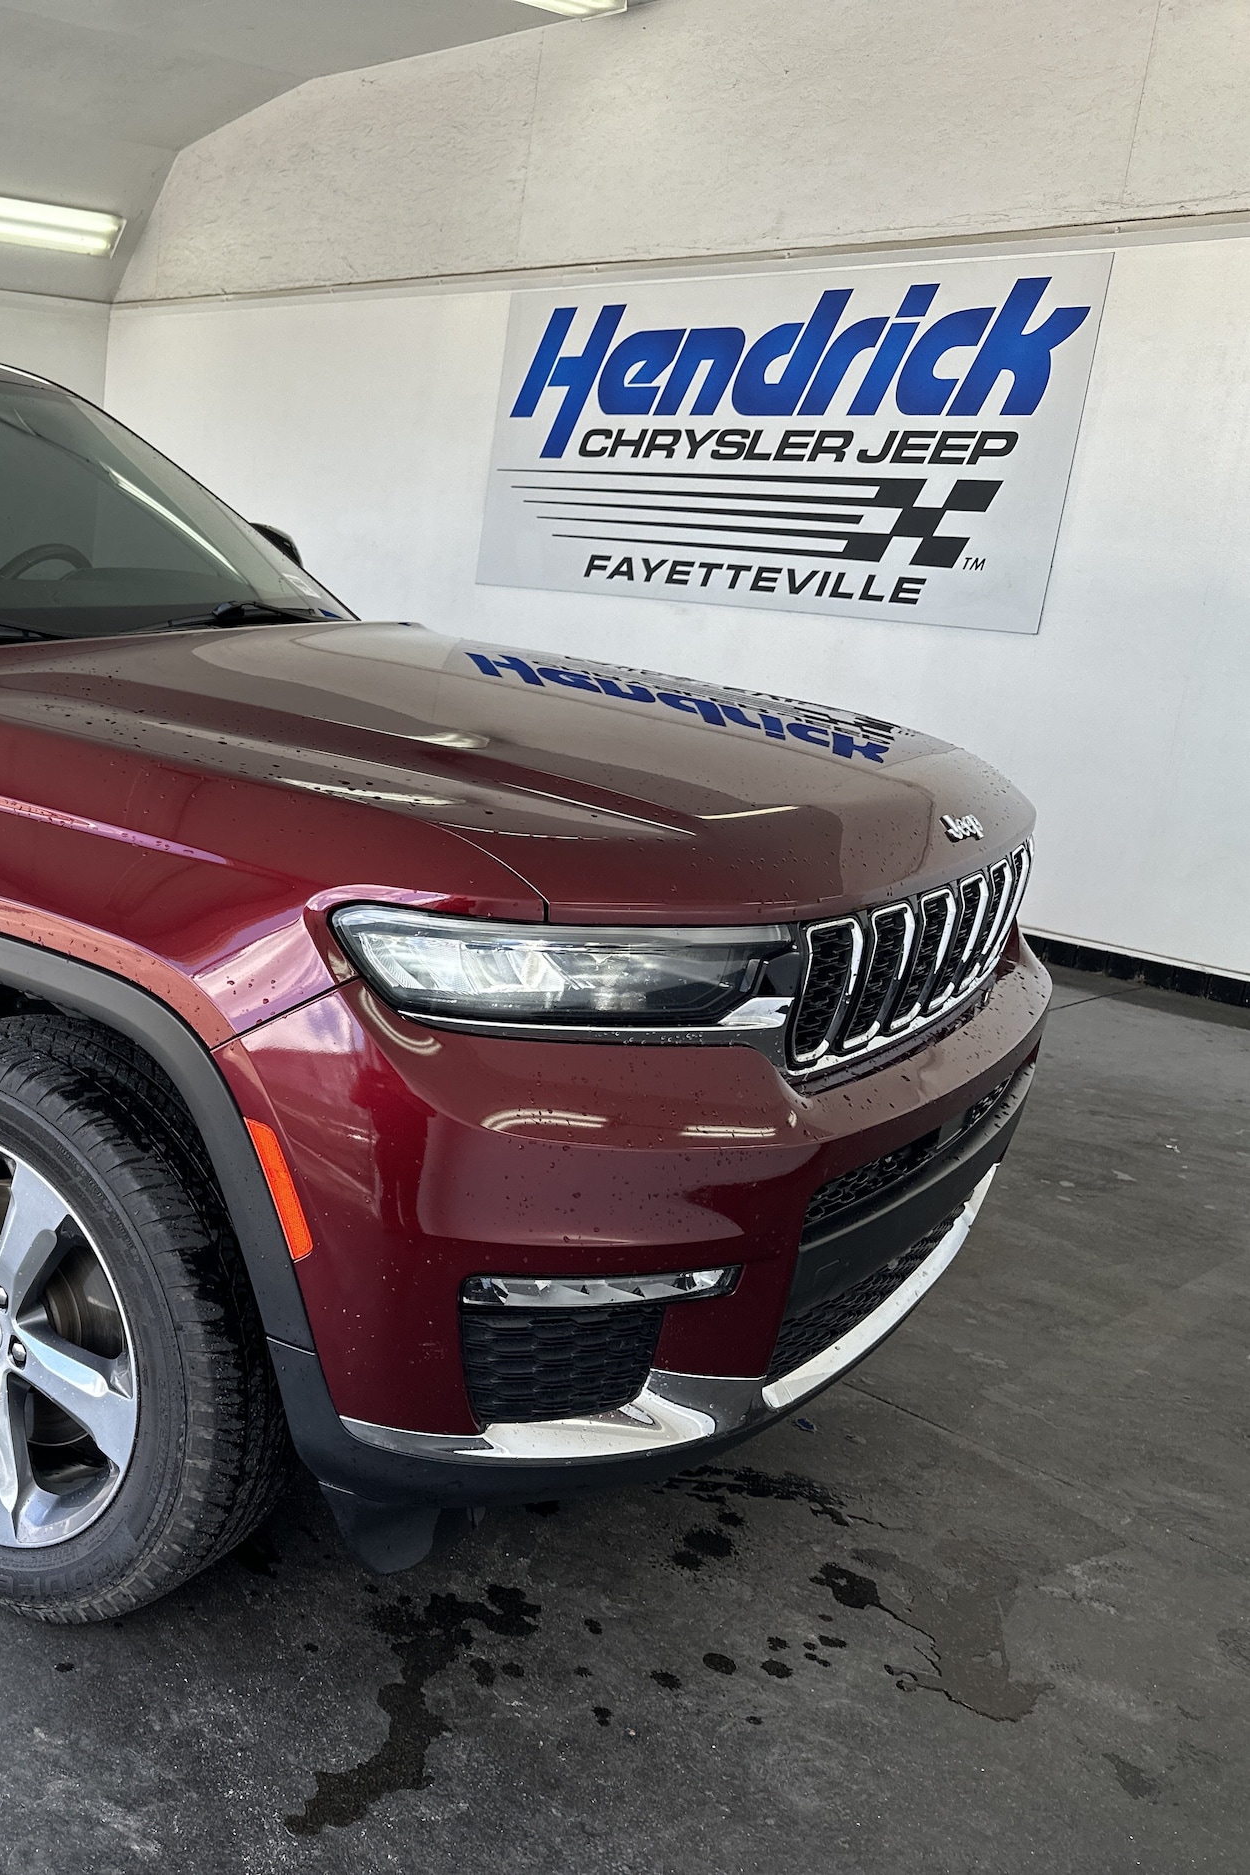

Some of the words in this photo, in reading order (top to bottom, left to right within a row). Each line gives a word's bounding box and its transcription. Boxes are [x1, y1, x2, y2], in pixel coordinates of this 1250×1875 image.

[509, 276, 1091, 458] Hendrick
[578, 428, 854, 462] CHRYSLER
[857, 430, 1019, 465] JEEP
[584, 555, 927, 605] FAYETTEVILLE
[961, 556, 986, 572] TM
[939, 813, 984, 843] Jeep
